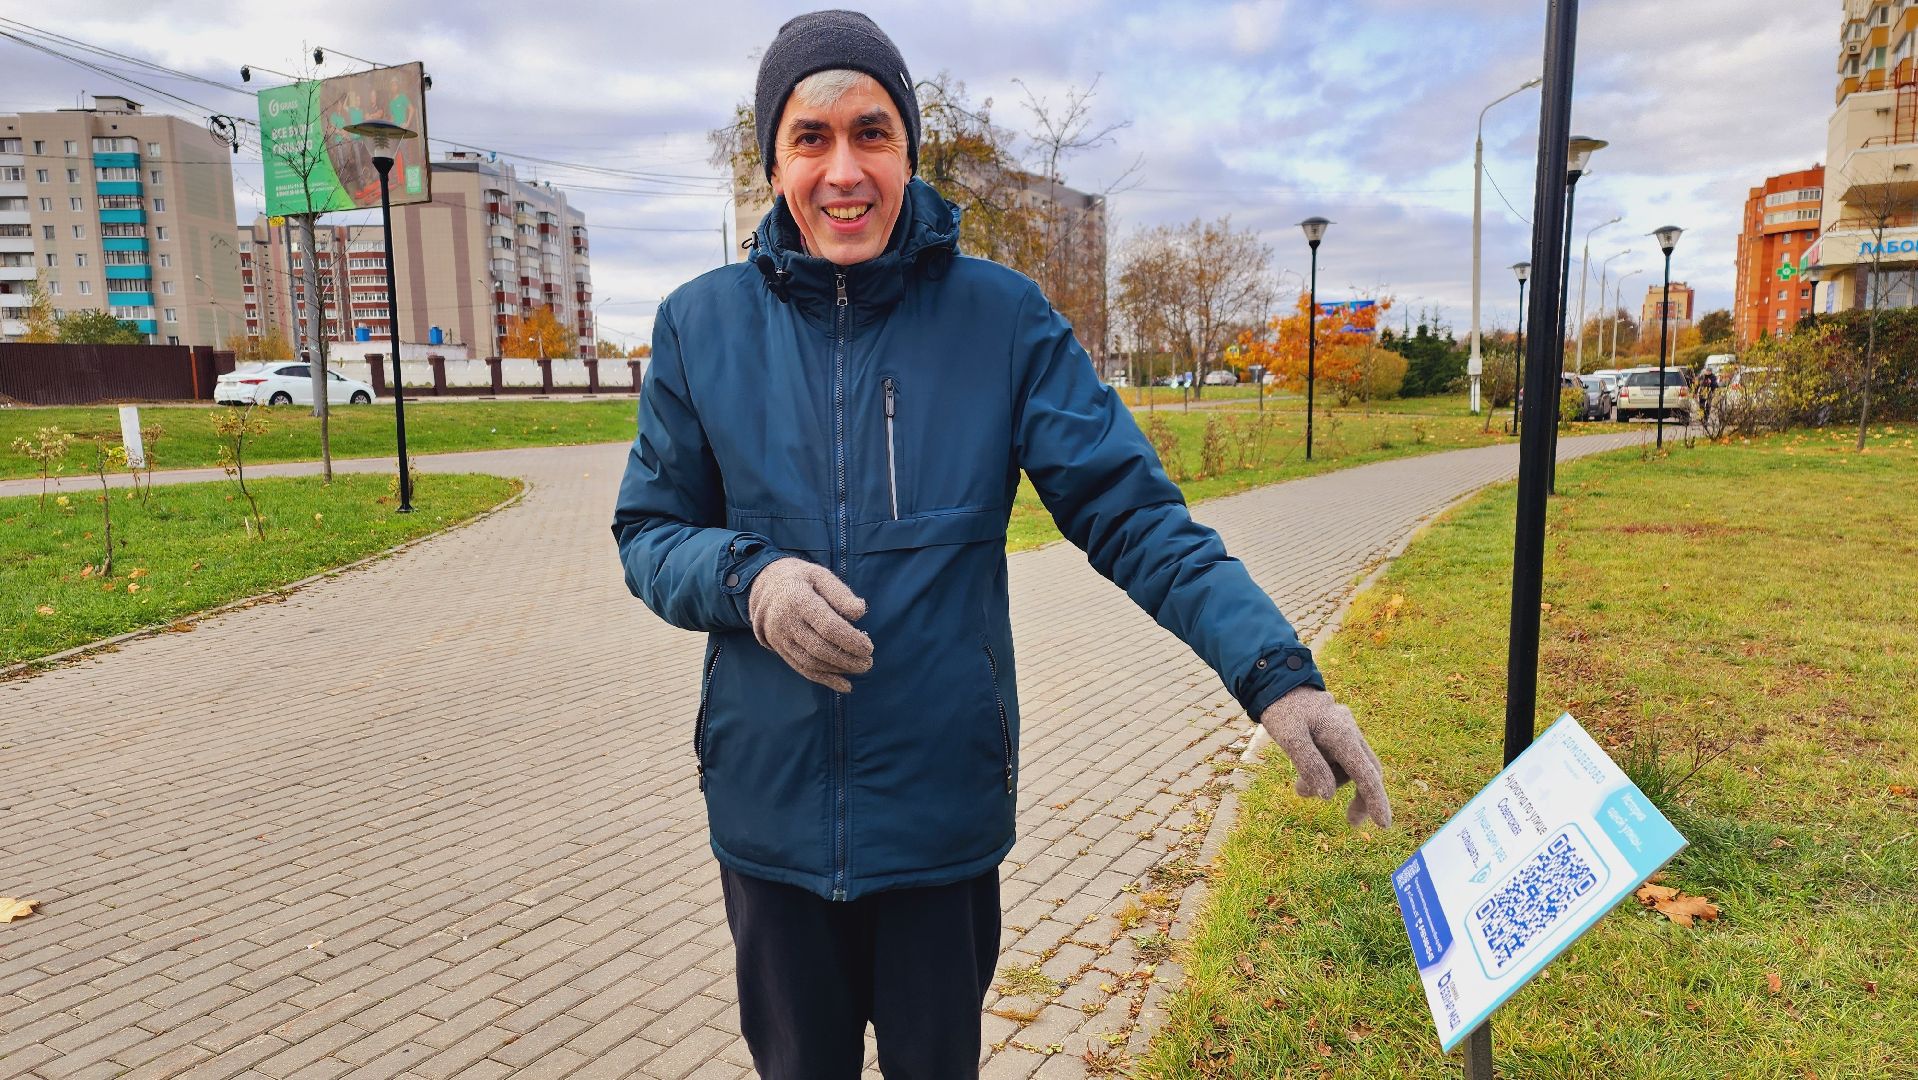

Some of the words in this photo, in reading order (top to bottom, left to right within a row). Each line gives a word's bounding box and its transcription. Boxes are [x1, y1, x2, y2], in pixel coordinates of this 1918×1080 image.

[1858, 239, 1918, 256] ЛАБО
[1562, 736, 1605, 784] ДОМОДЕДОВО
[1505, 773, 1529, 806] Аудиогид
[1497, 797, 1522, 836] Советская
[1523, 802, 1534, 815] по
[1526, 809, 1548, 836] улице
[1486, 829, 1500, 847] один
[1448, 1009, 1461, 1031] МЕД
